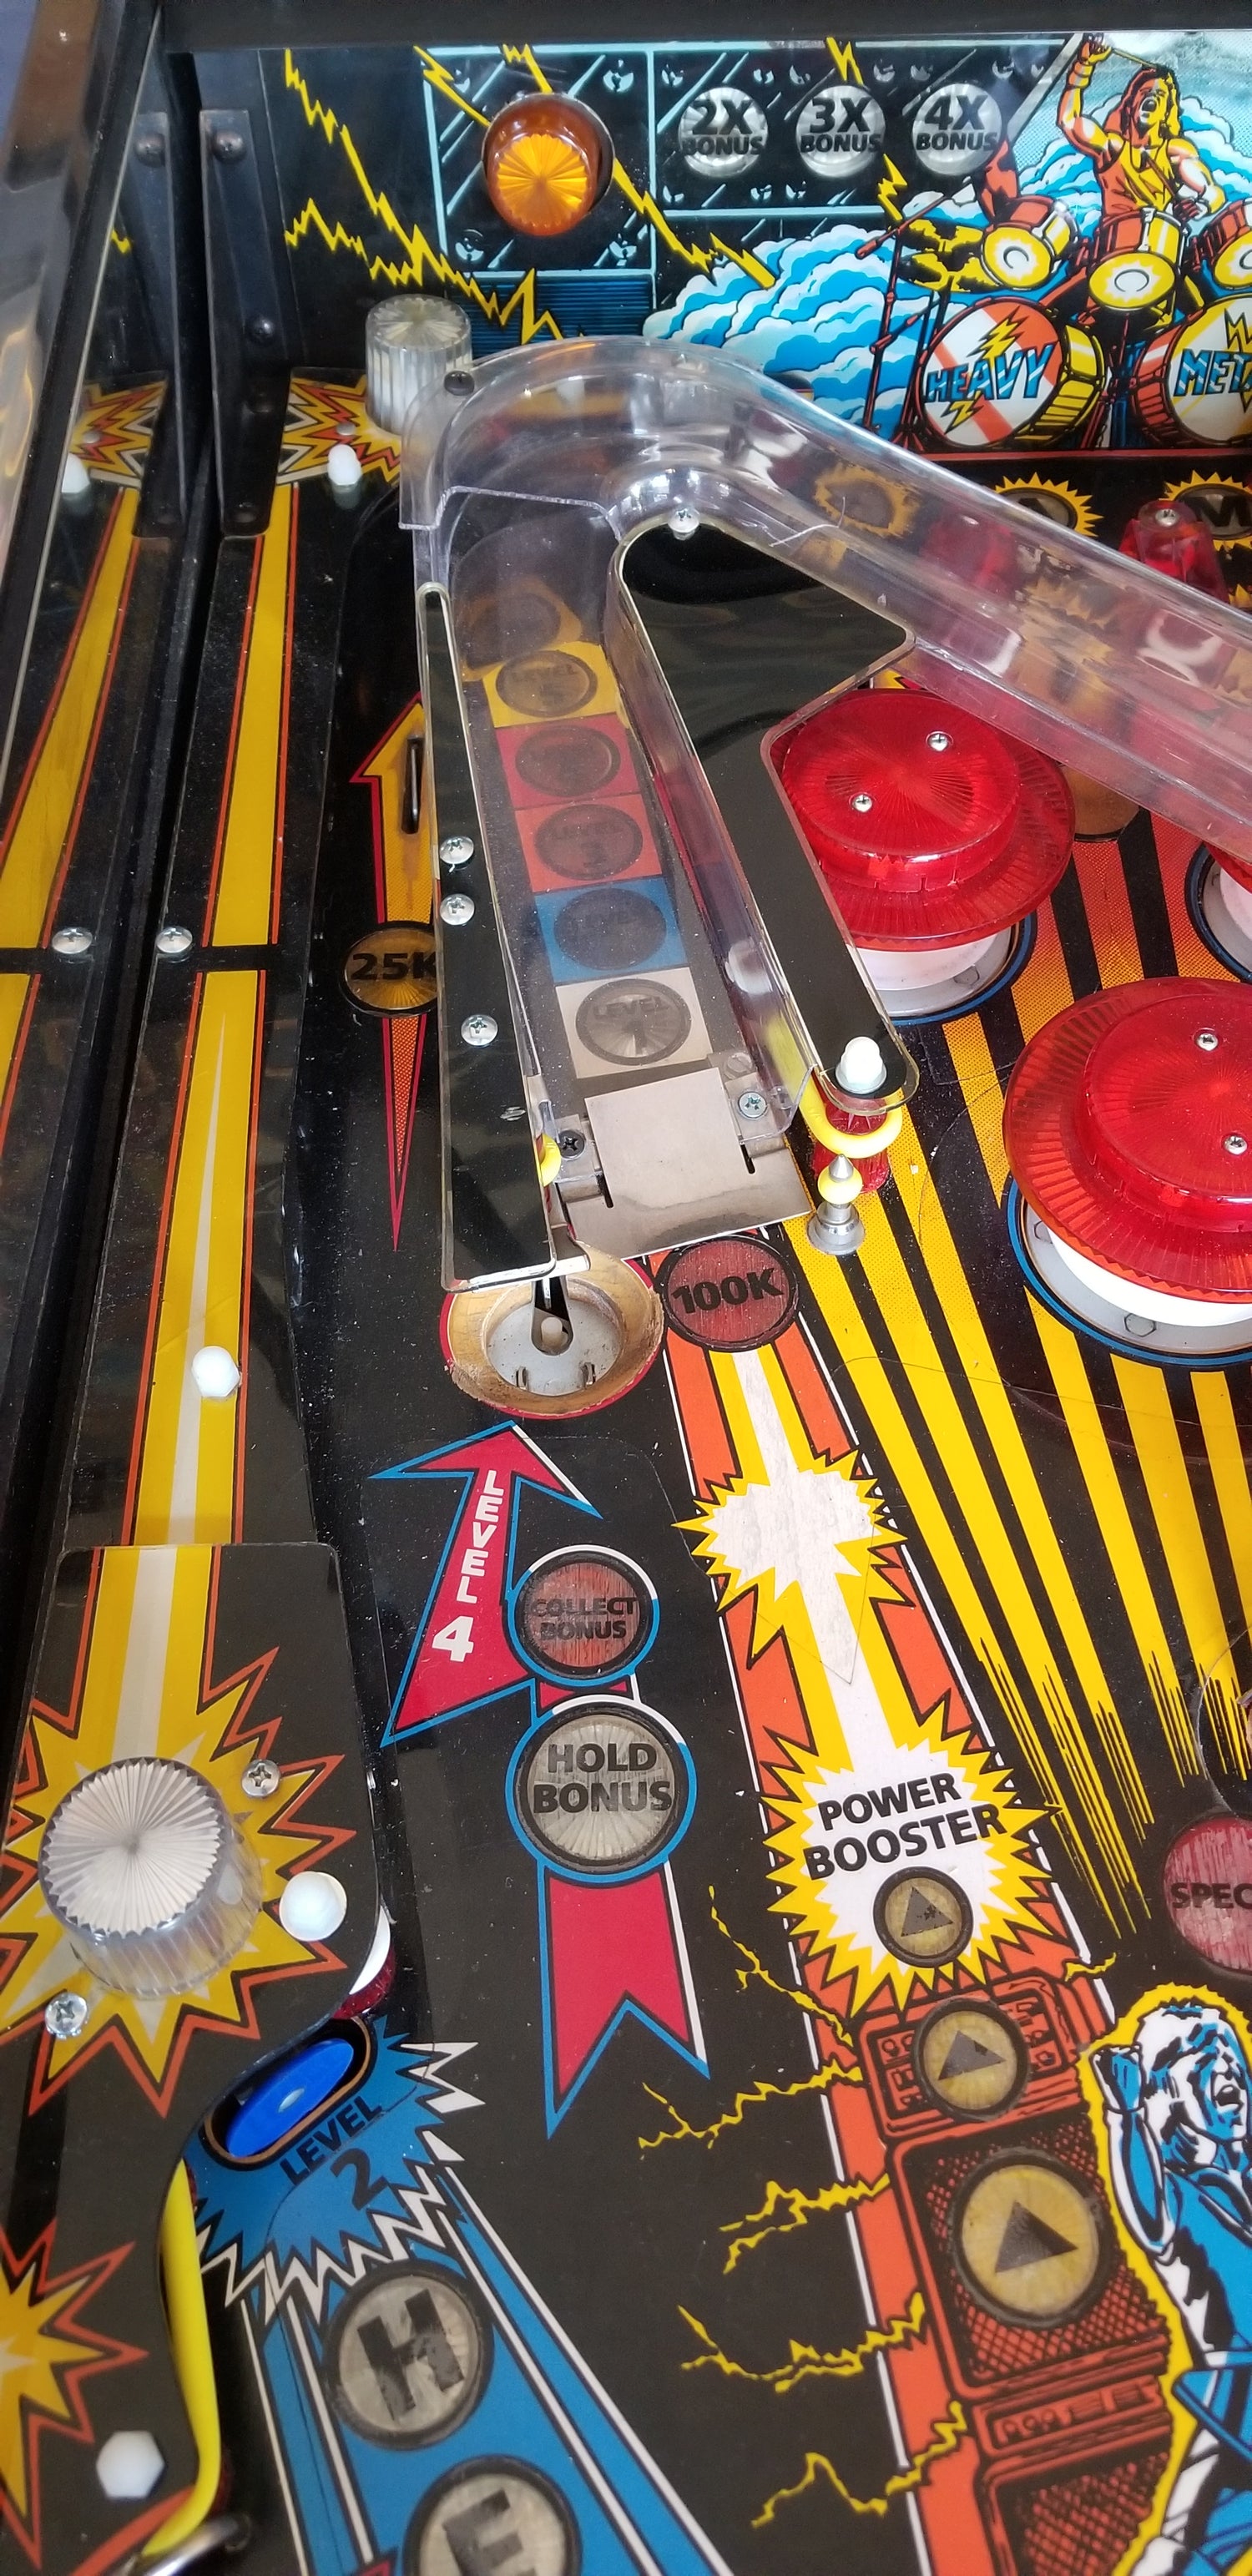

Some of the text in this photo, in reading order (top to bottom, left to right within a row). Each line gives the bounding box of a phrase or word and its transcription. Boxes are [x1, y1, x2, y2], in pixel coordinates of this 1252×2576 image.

[692, 98, 753, 135] 2X
[810, 96, 871, 134] 3X
[923, 94, 988, 132] 4X
[681, 135, 765, 157] BONUS
[800, 134, 883, 154] BONUS
[916, 130, 1000, 151] BONUS
[925, 340, 1058, 402] HEAVY
[593, 997, 669, 1019] LEVEL
[671, 1268, 785, 1314] 100K
[432, 1469, 505, 1663] LEVEL 4
[531, 1596, 638, 1617] COLLECT
[540, 1620, 627, 1640] BONUS
[547, 1742, 658, 1778] HOLD
[533, 1780, 671, 1816] BONUS
[817, 1772, 962, 1832] POWER
[802, 1802, 1007, 1881] BOOSTER
[279, 2095, 383, 2186] LEVEL
[330, 2148, 389, 2211] 2
[356, 2287, 464, 2422] H
